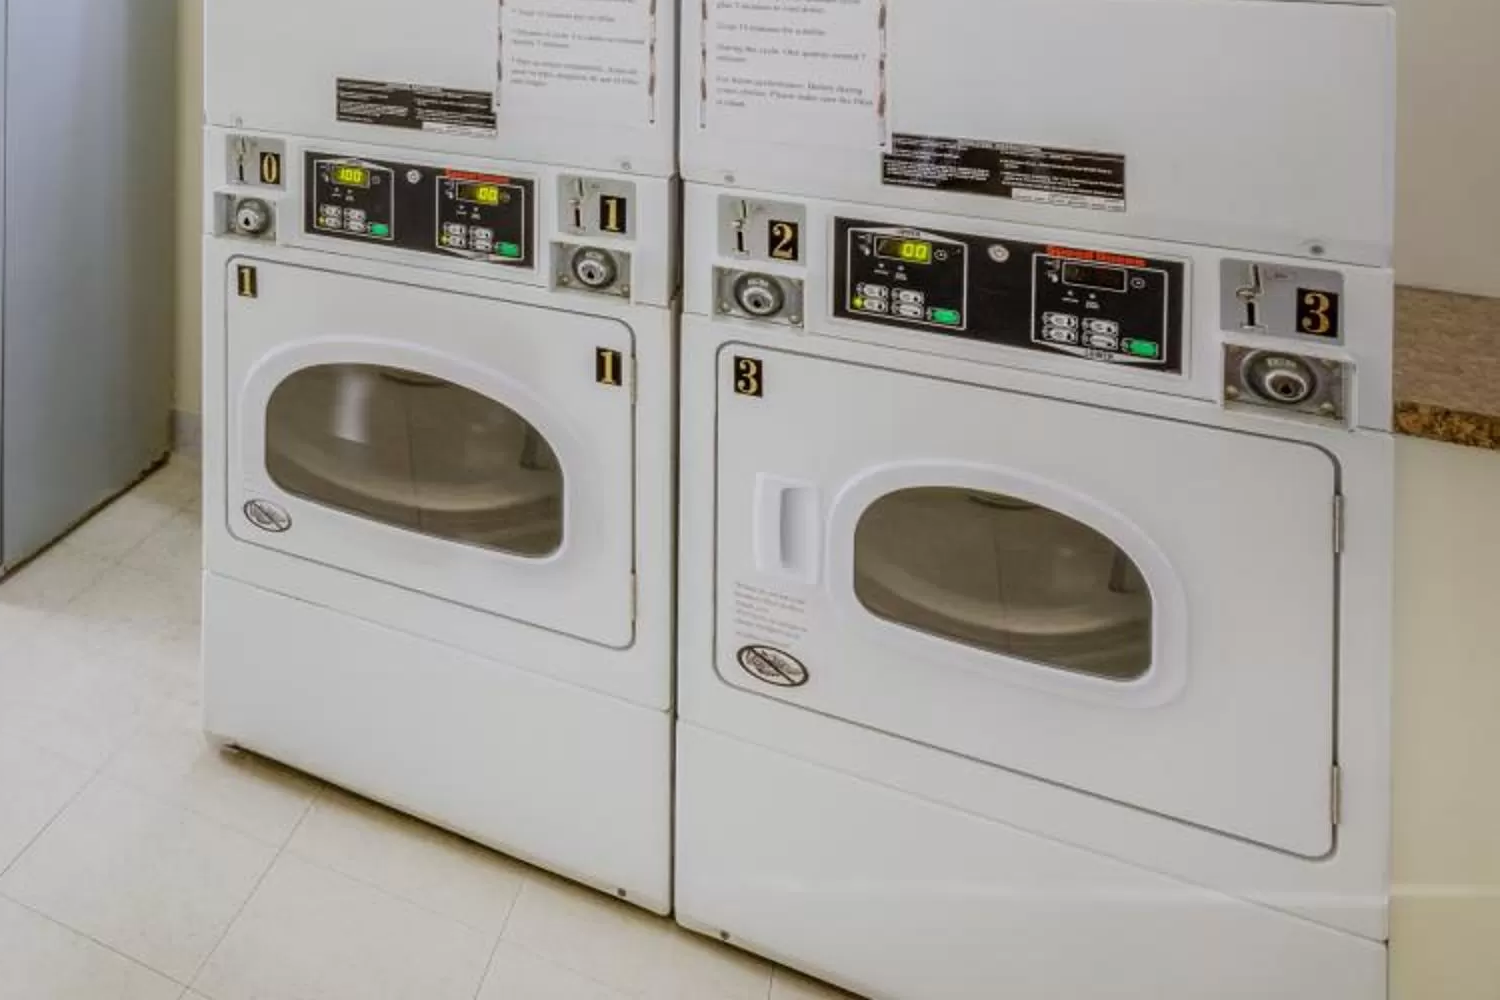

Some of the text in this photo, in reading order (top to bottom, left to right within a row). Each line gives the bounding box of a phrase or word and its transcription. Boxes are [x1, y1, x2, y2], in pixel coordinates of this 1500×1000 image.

[262, 153, 278, 183] 0
[771, 222, 794, 259] 2
[1301, 291, 1331, 334] 3
[737, 359, 759, 395] 3
